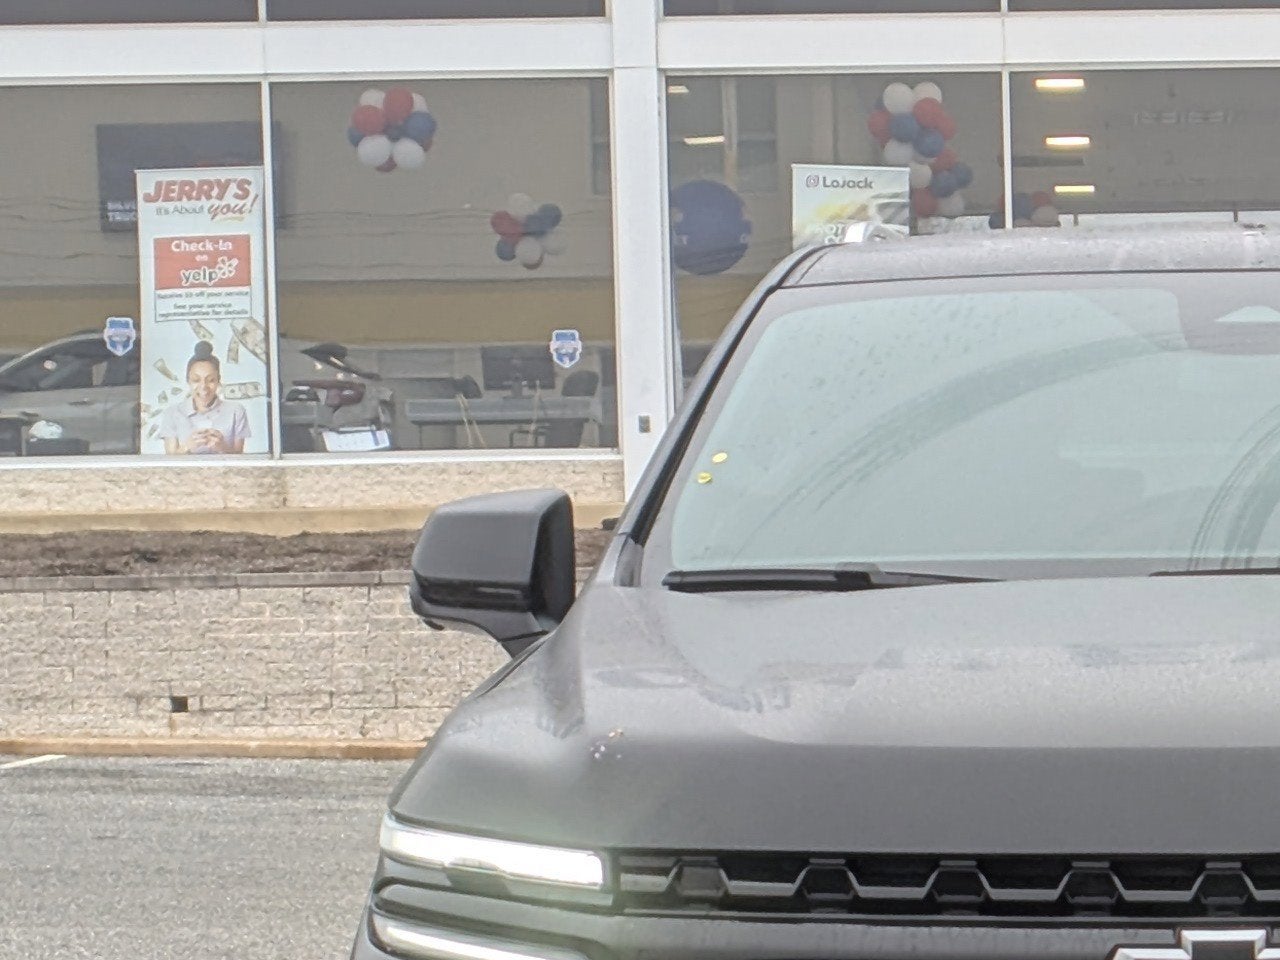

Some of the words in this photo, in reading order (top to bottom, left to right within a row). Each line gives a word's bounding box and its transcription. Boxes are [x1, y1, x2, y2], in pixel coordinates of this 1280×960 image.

[142, 178, 252, 203] JERRY'S
[822, 176, 874, 189] LoJack
[155, 206, 170, 216] It's
[171, 204, 205, 214] About
[208, 194, 259, 220] you!
[171, 239, 233, 252] Check-in
[180, 266, 219, 287] yelp
